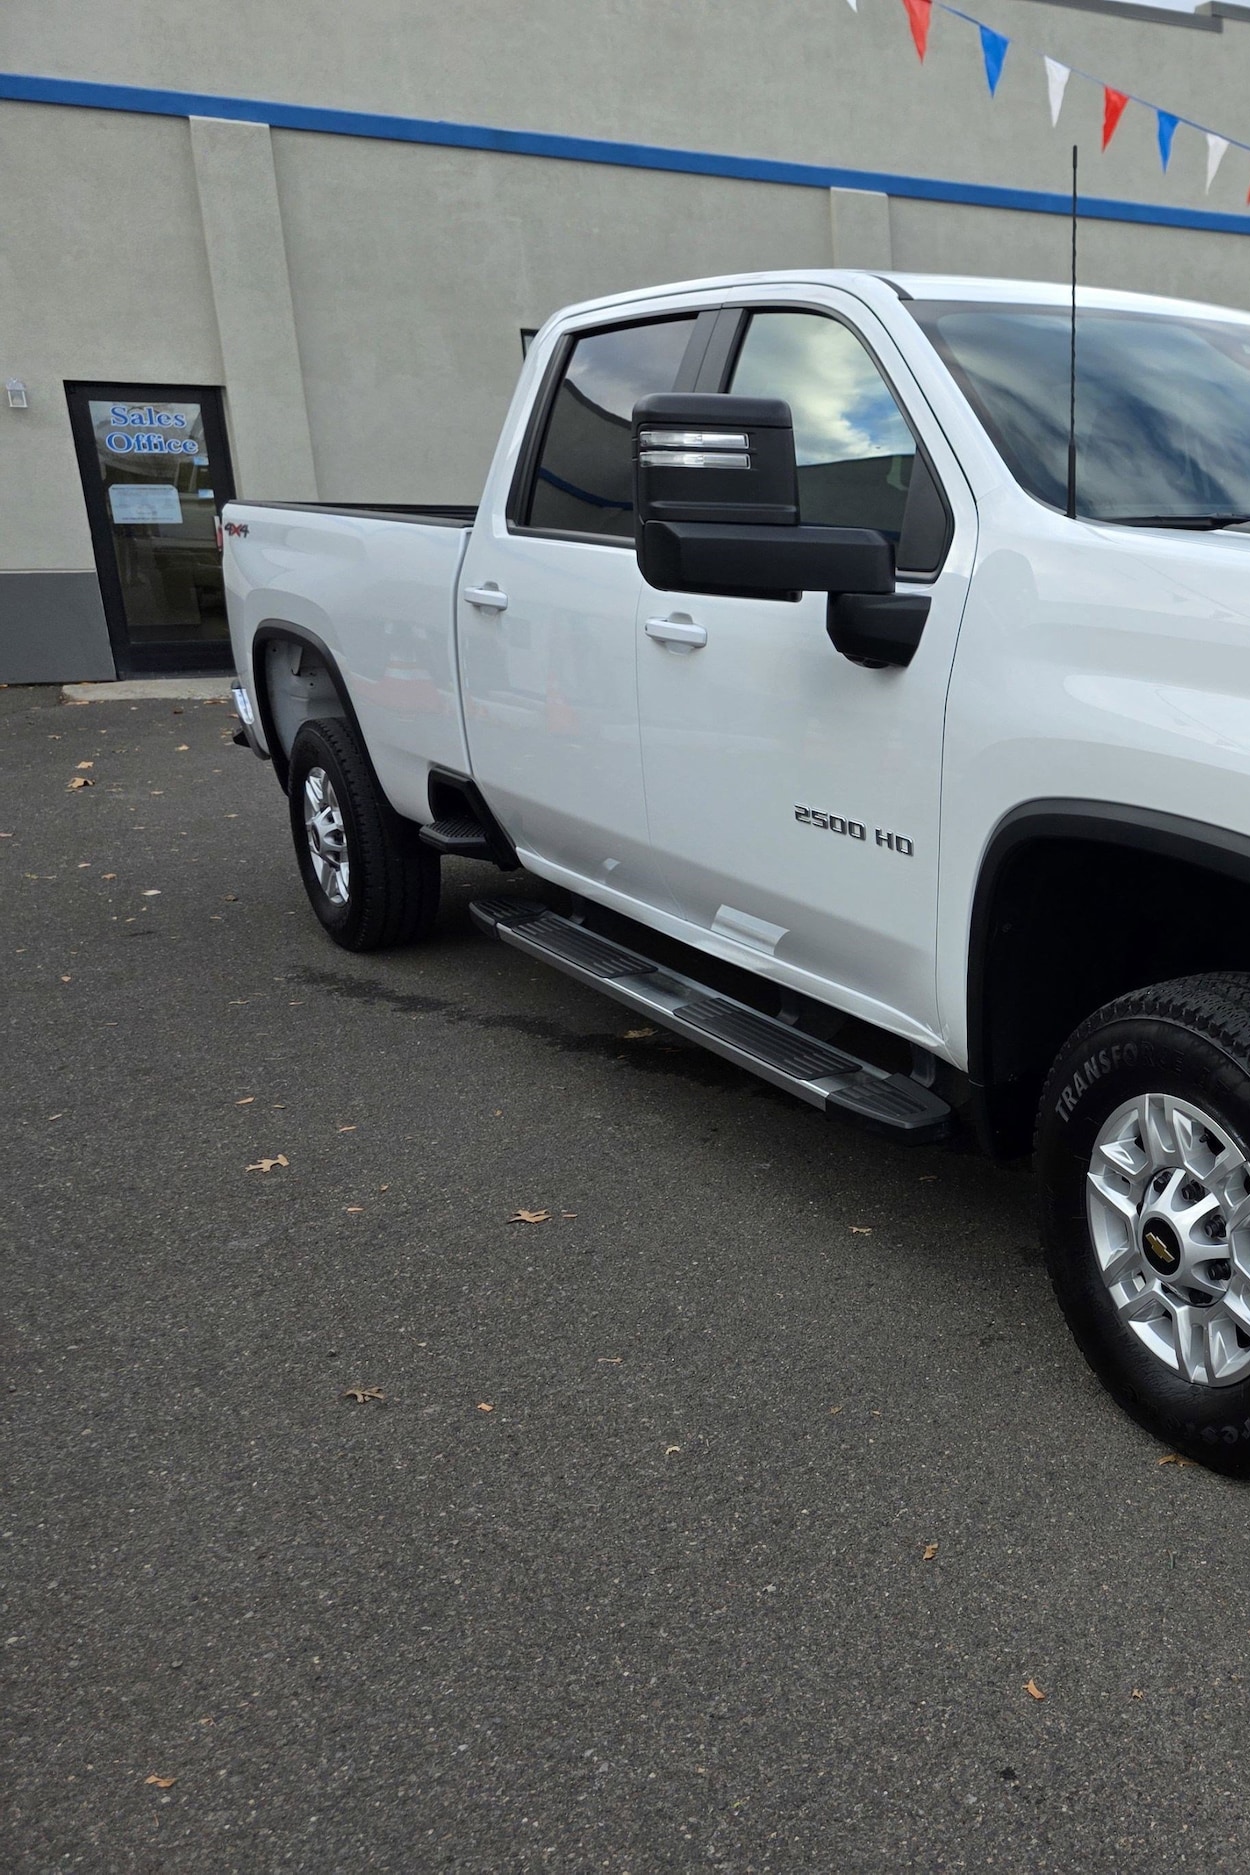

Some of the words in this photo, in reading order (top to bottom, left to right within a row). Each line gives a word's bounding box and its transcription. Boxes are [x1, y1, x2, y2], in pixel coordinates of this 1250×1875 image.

[110, 405, 187, 429] Sales
[106, 431, 199, 454] Office
[794, 803, 867, 841] 2500
[875, 826, 915, 857] HD
